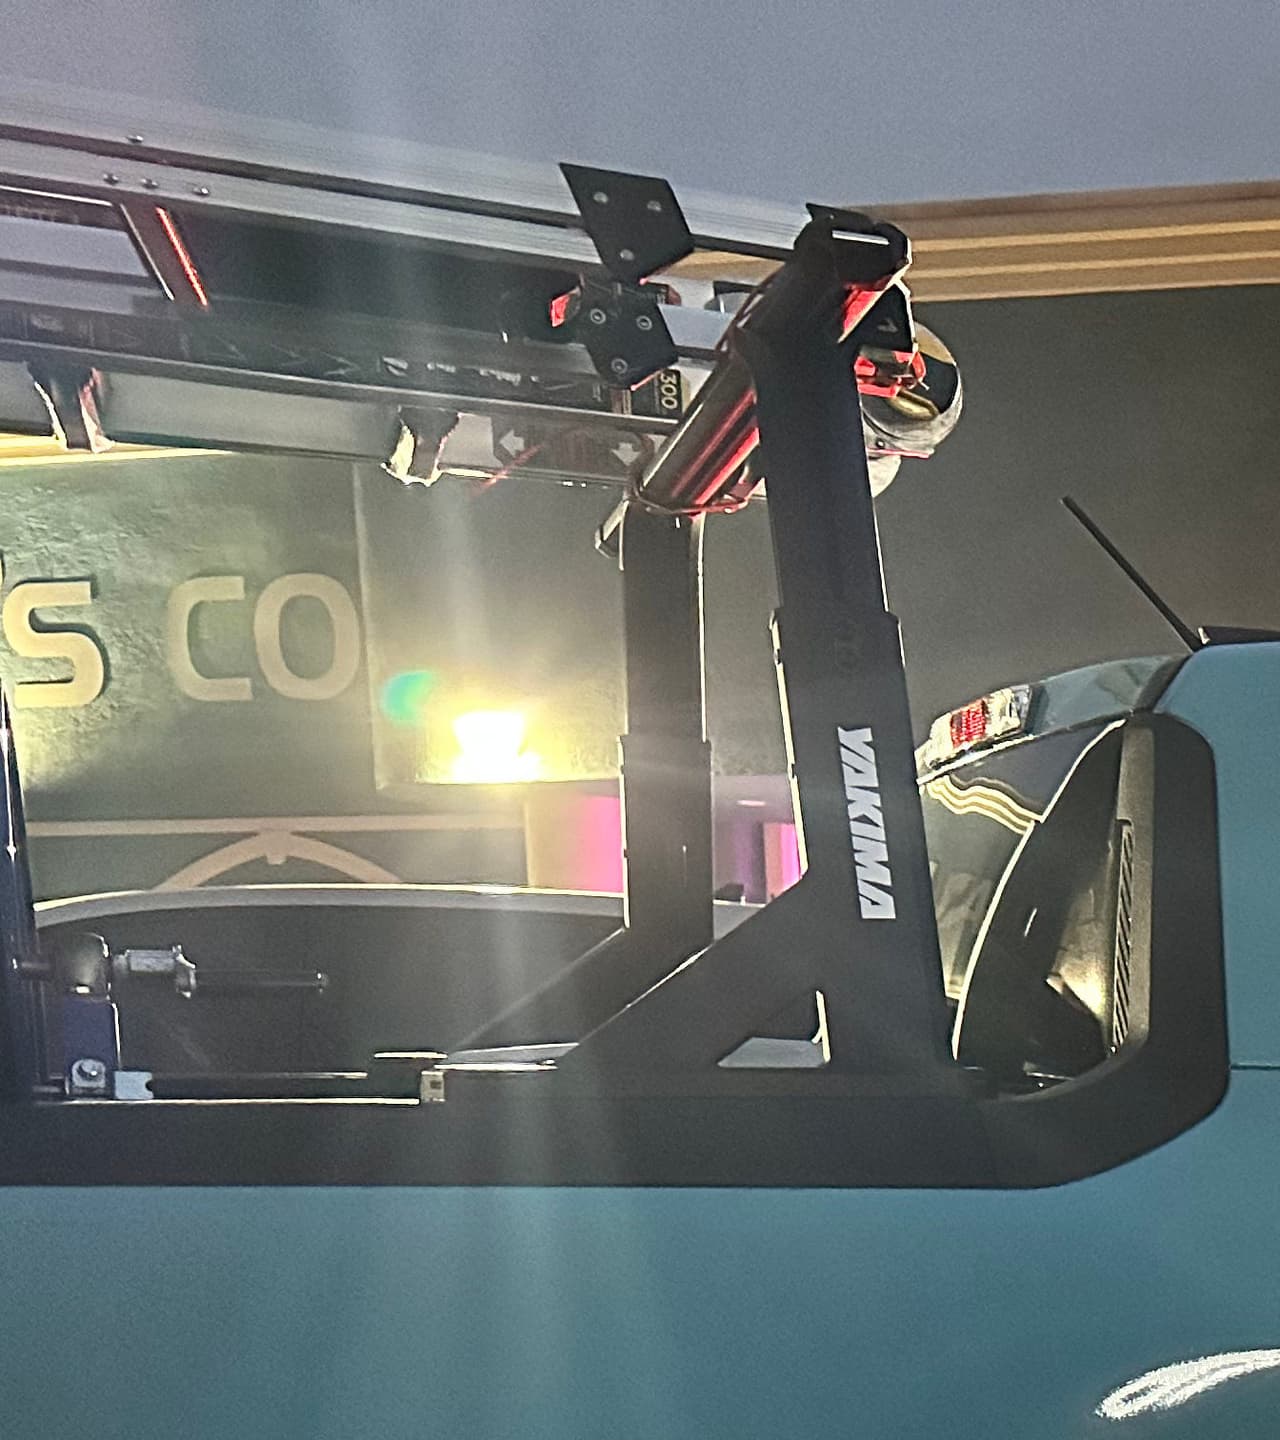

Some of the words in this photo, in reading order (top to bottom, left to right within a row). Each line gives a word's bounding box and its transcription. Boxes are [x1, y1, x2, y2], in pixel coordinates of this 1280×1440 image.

[660, 372, 678, 410] 300
[167, 572, 361, 701] CO
[838, 727, 896, 919] YAKIMA
